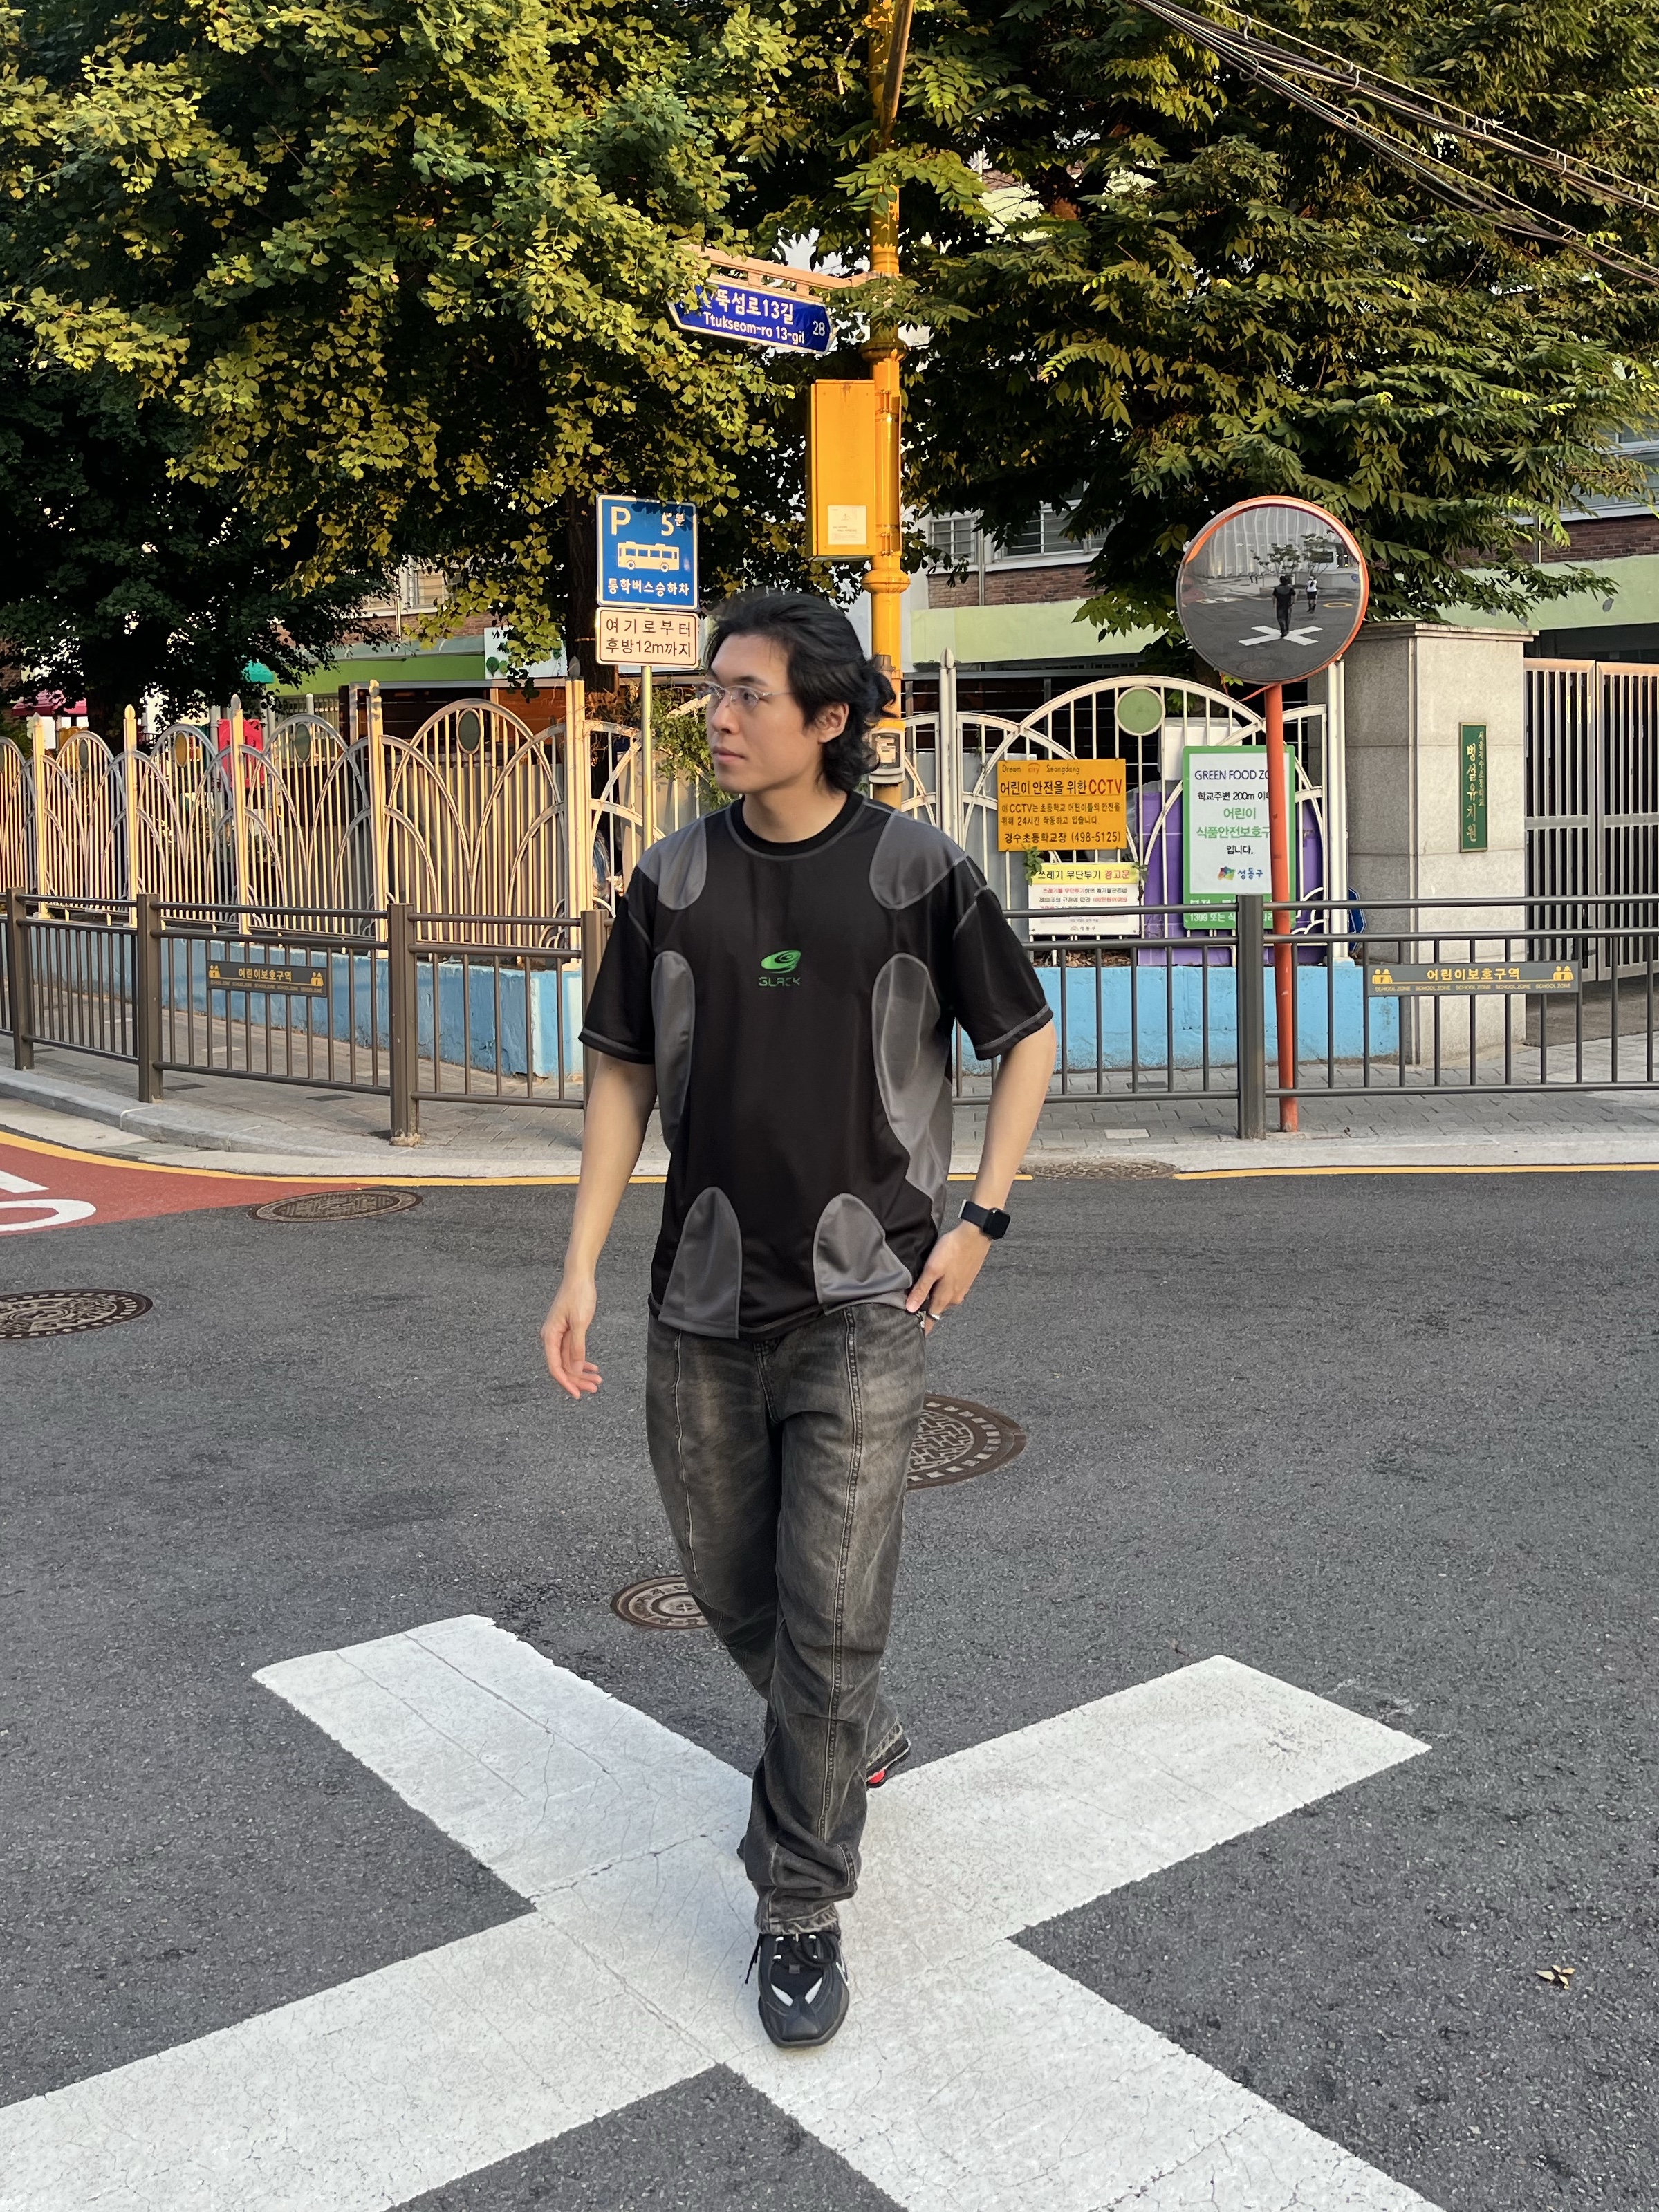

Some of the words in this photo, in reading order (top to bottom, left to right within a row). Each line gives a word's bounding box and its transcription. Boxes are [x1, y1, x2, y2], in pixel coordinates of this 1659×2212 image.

[715, 288, 793, 326] 뚝섬로13길
[703, 311, 773, 337] Ttukseom-ro
[812, 320, 826, 336] 28
[610, 506, 631, 535] P
[607, 578, 689, 597] 통학버스승하차
[606, 617, 691, 638] 여기로부터
[1003, 765, 1021, 773] Dream
[1046, 764, 1080, 774] Seongdong
[1194, 770, 1227, 780] GREEN
[1229, 770, 1257, 780] FOOD
[1000, 780, 1030, 795] 어린이
[1032, 780, 1064, 795] 안전을
[1088, 779, 1122, 794] CCTV
[1466, 743, 1478, 842] 병설유치원
[1198, 791, 1230, 801] 학교주변
[1232, 792, 1255, 801] 200m
[1009, 803, 1039, 813] CCTV는
[1040, 803, 1065, 812] 초등학교
[1223, 807, 1257, 820] 어린이
[1017, 816, 1040, 826] 24시간
[1043, 816, 1068, 826] 작동하고
[1004, 833, 1066, 844] 경수초등학교장
[1071, 831, 1121, 844] (498-5125)
[1226, 845, 1254, 855] 입니다.
[1038, 870, 1064, 880] 쓰레기
[1066, 870, 1101, 880] 무단투기
[1104, 869, 1130, 880] 경고문
[1237, 867, 1263, 880] 성동구
[1189, 913, 1208, 922] 1399
[1210, 913, 1225, 922] 또는
[238, 967, 292, 982] 어린이보호구역
[1427, 967, 1520, 981] 어린이보호구역
